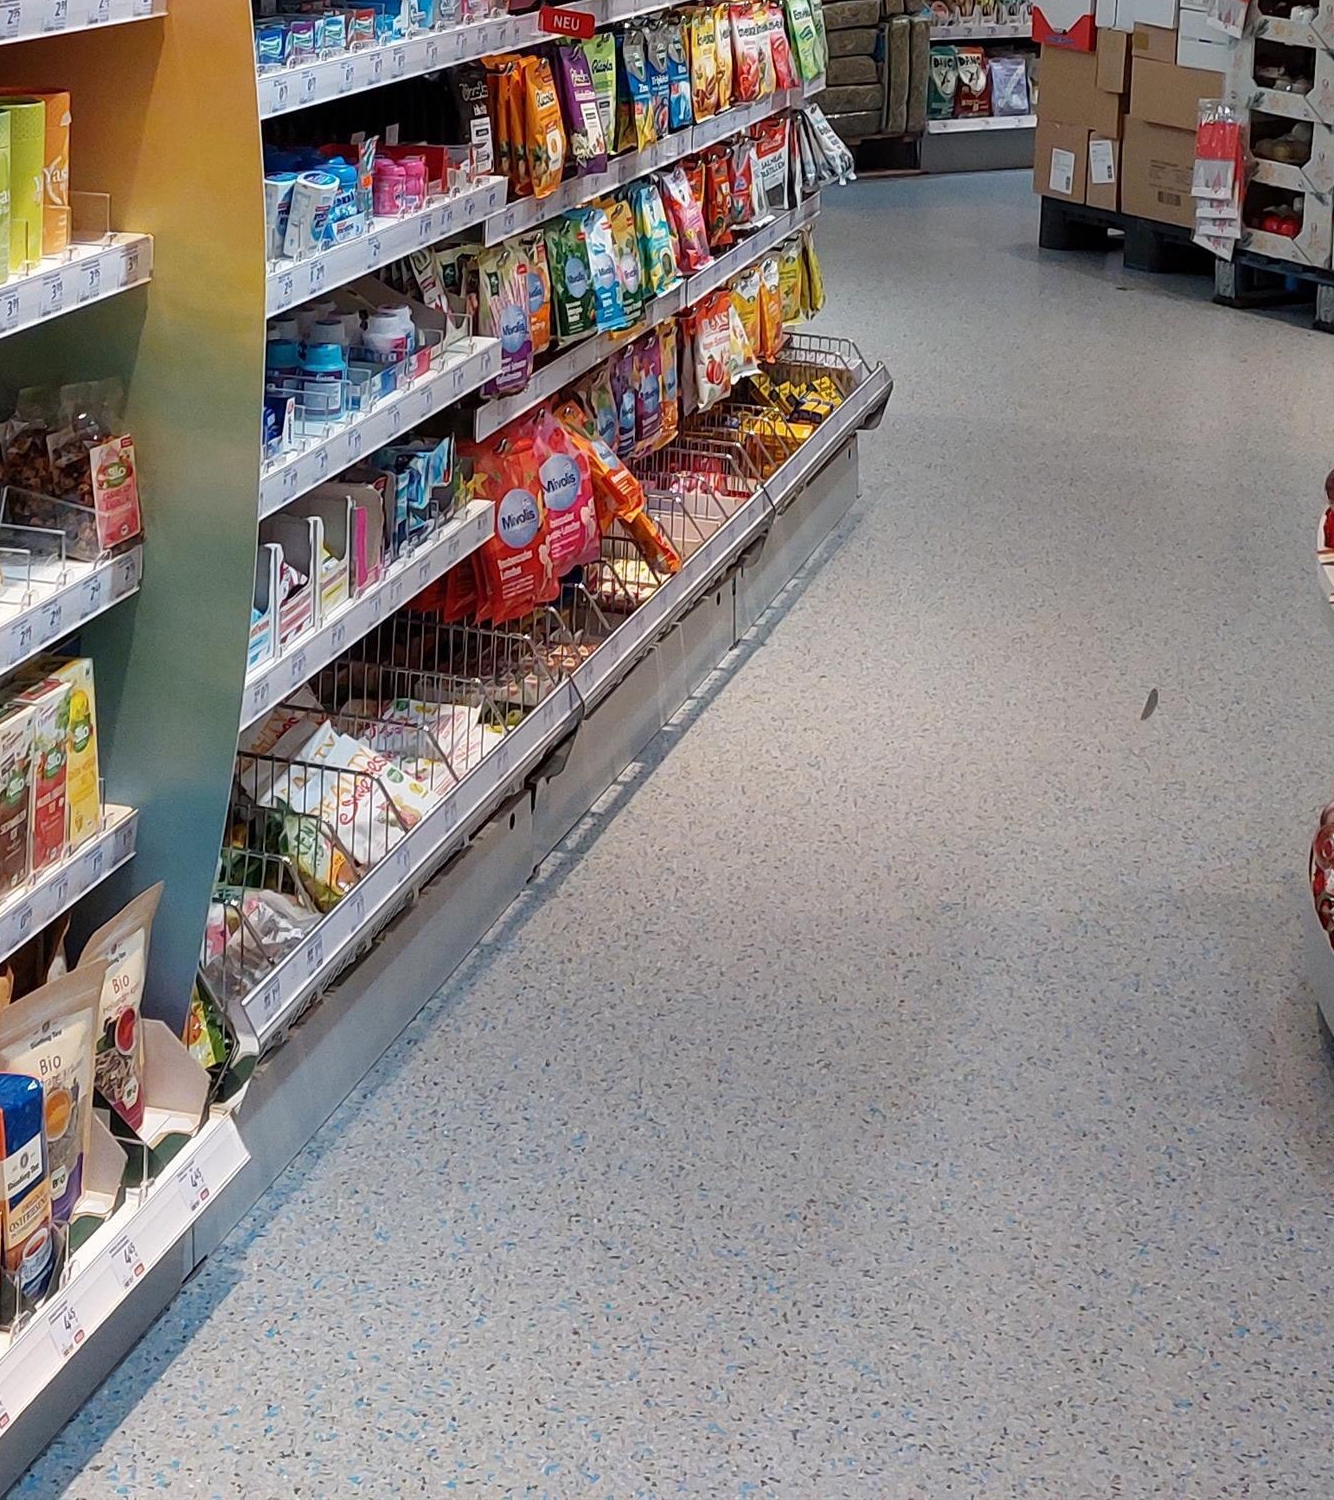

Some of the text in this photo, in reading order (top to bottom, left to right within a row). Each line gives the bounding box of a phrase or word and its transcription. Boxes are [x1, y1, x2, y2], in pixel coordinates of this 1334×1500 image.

[553, 14, 581, 31] NEU
[501, 505, 536, 532] Mivolis
[112, 973, 130, 994] Bio
[39, 1055, 62, 1075] Bio
